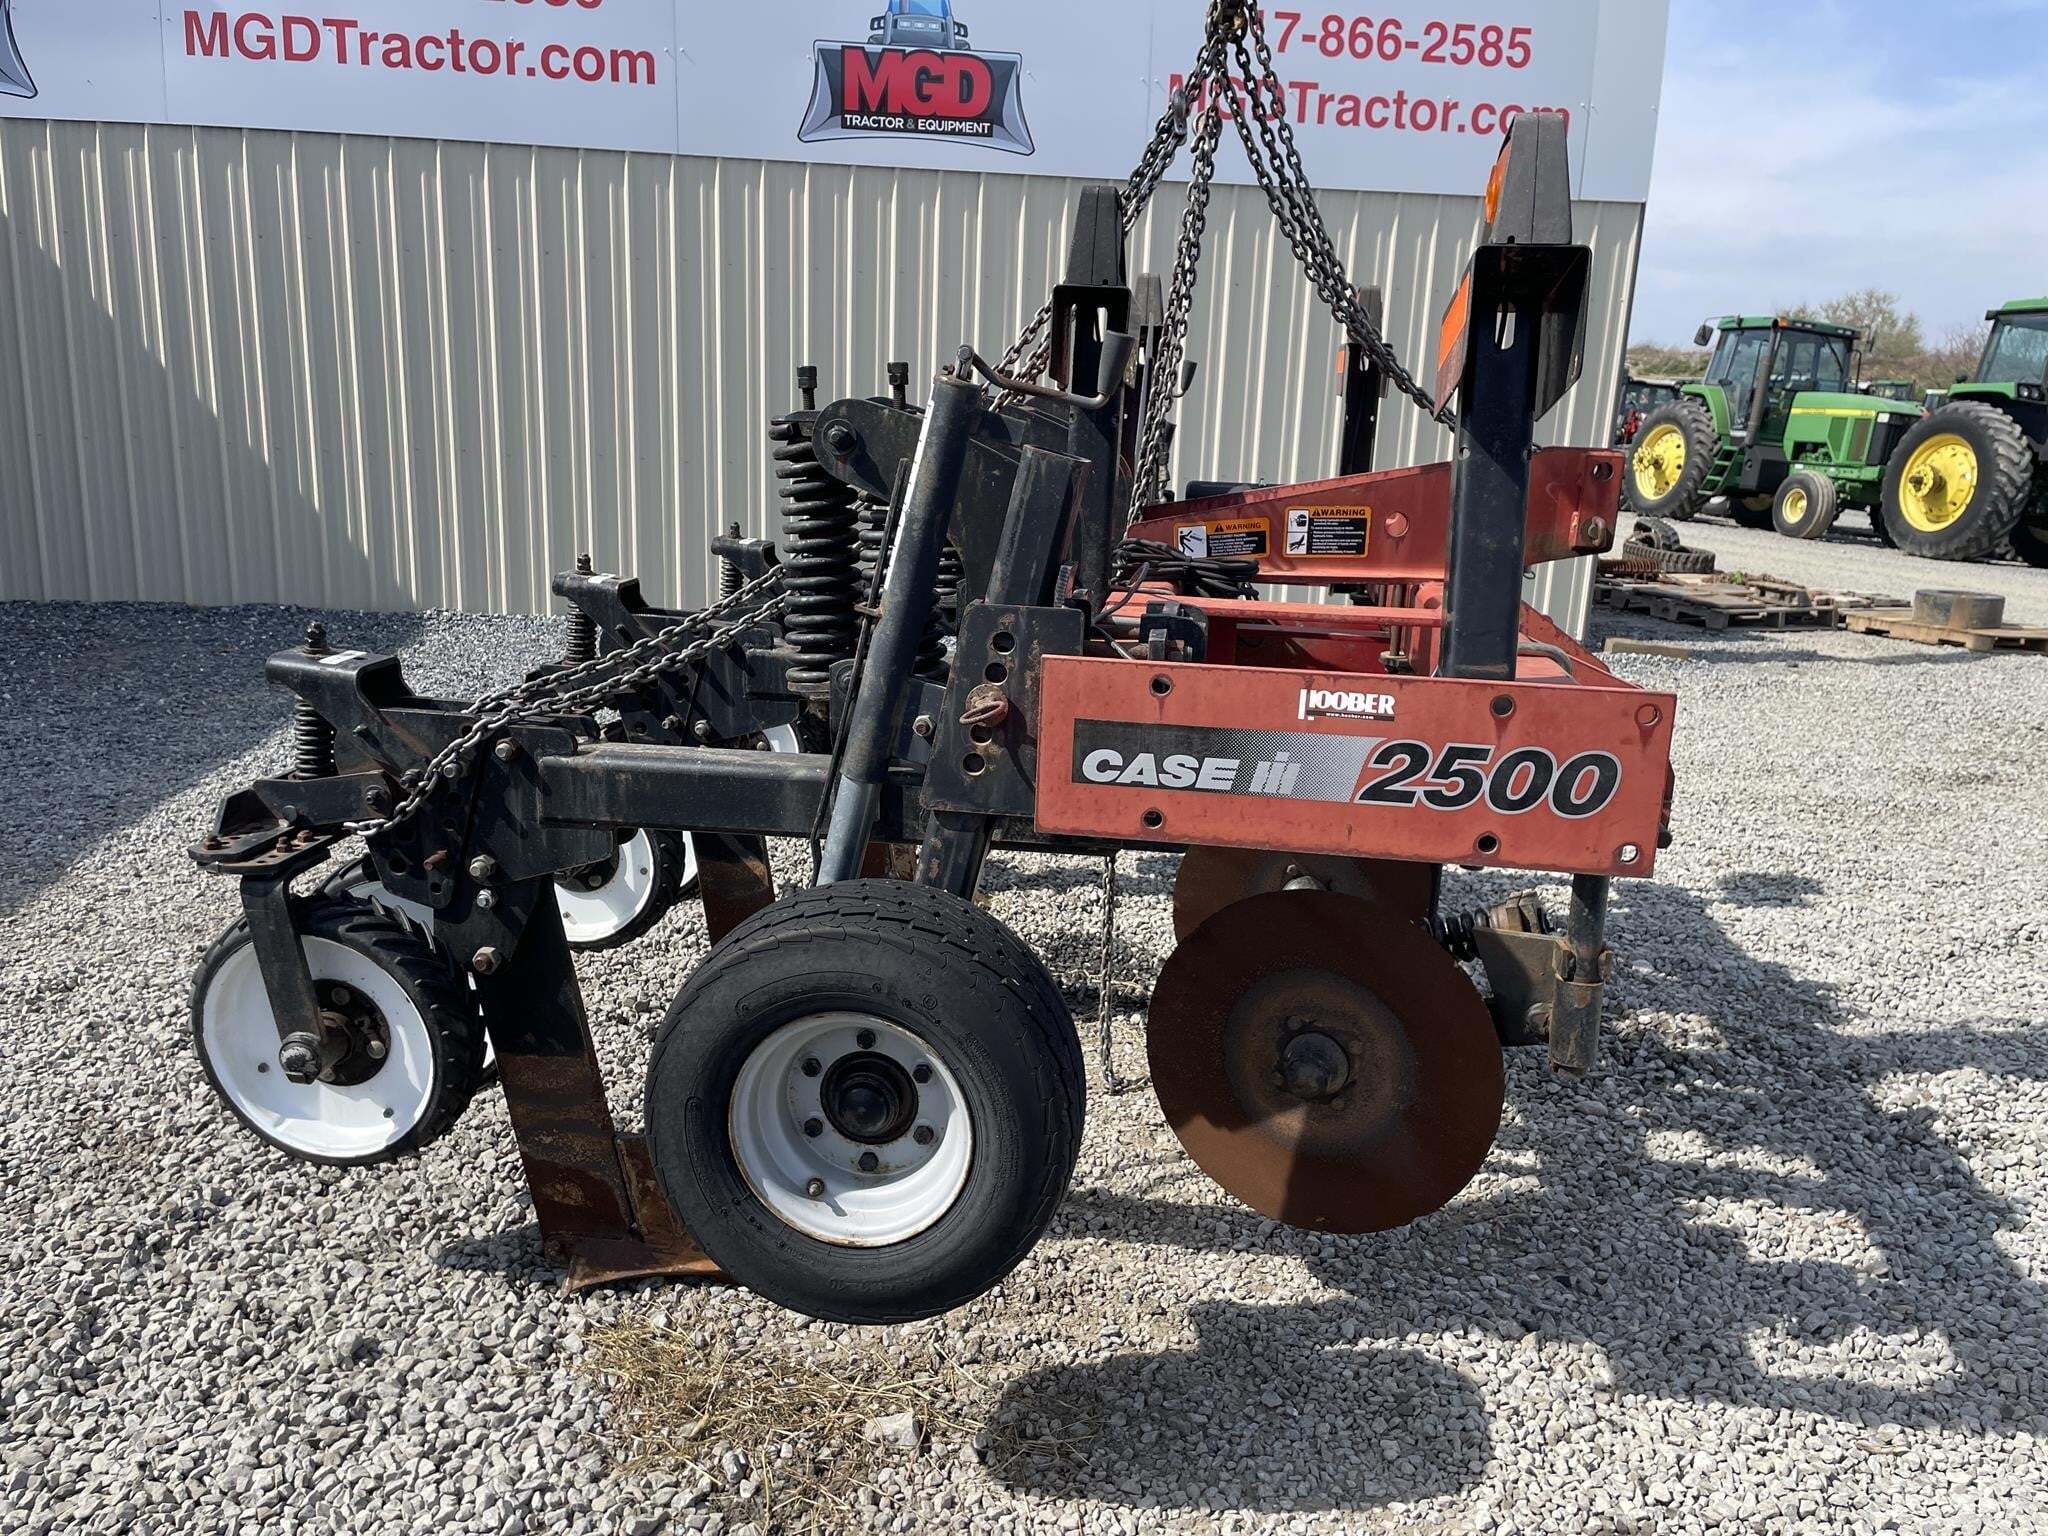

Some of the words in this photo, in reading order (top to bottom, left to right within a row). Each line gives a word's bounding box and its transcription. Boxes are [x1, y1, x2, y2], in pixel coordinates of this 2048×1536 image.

[185, 10, 656, 84] MGDTractor.com
[842, 46, 993, 117] MGD
[844, 114, 904, 129] TRACTOR
[906, 118, 915, 129] &
[917, 118, 991, 134] EQUIPMENT
[1225, 521, 1262, 531] WARNING
[1321, 508, 1366, 517] WARNING
[1082, 749, 1240, 790] CASE
[1353, 740, 1622, 819] 2500
